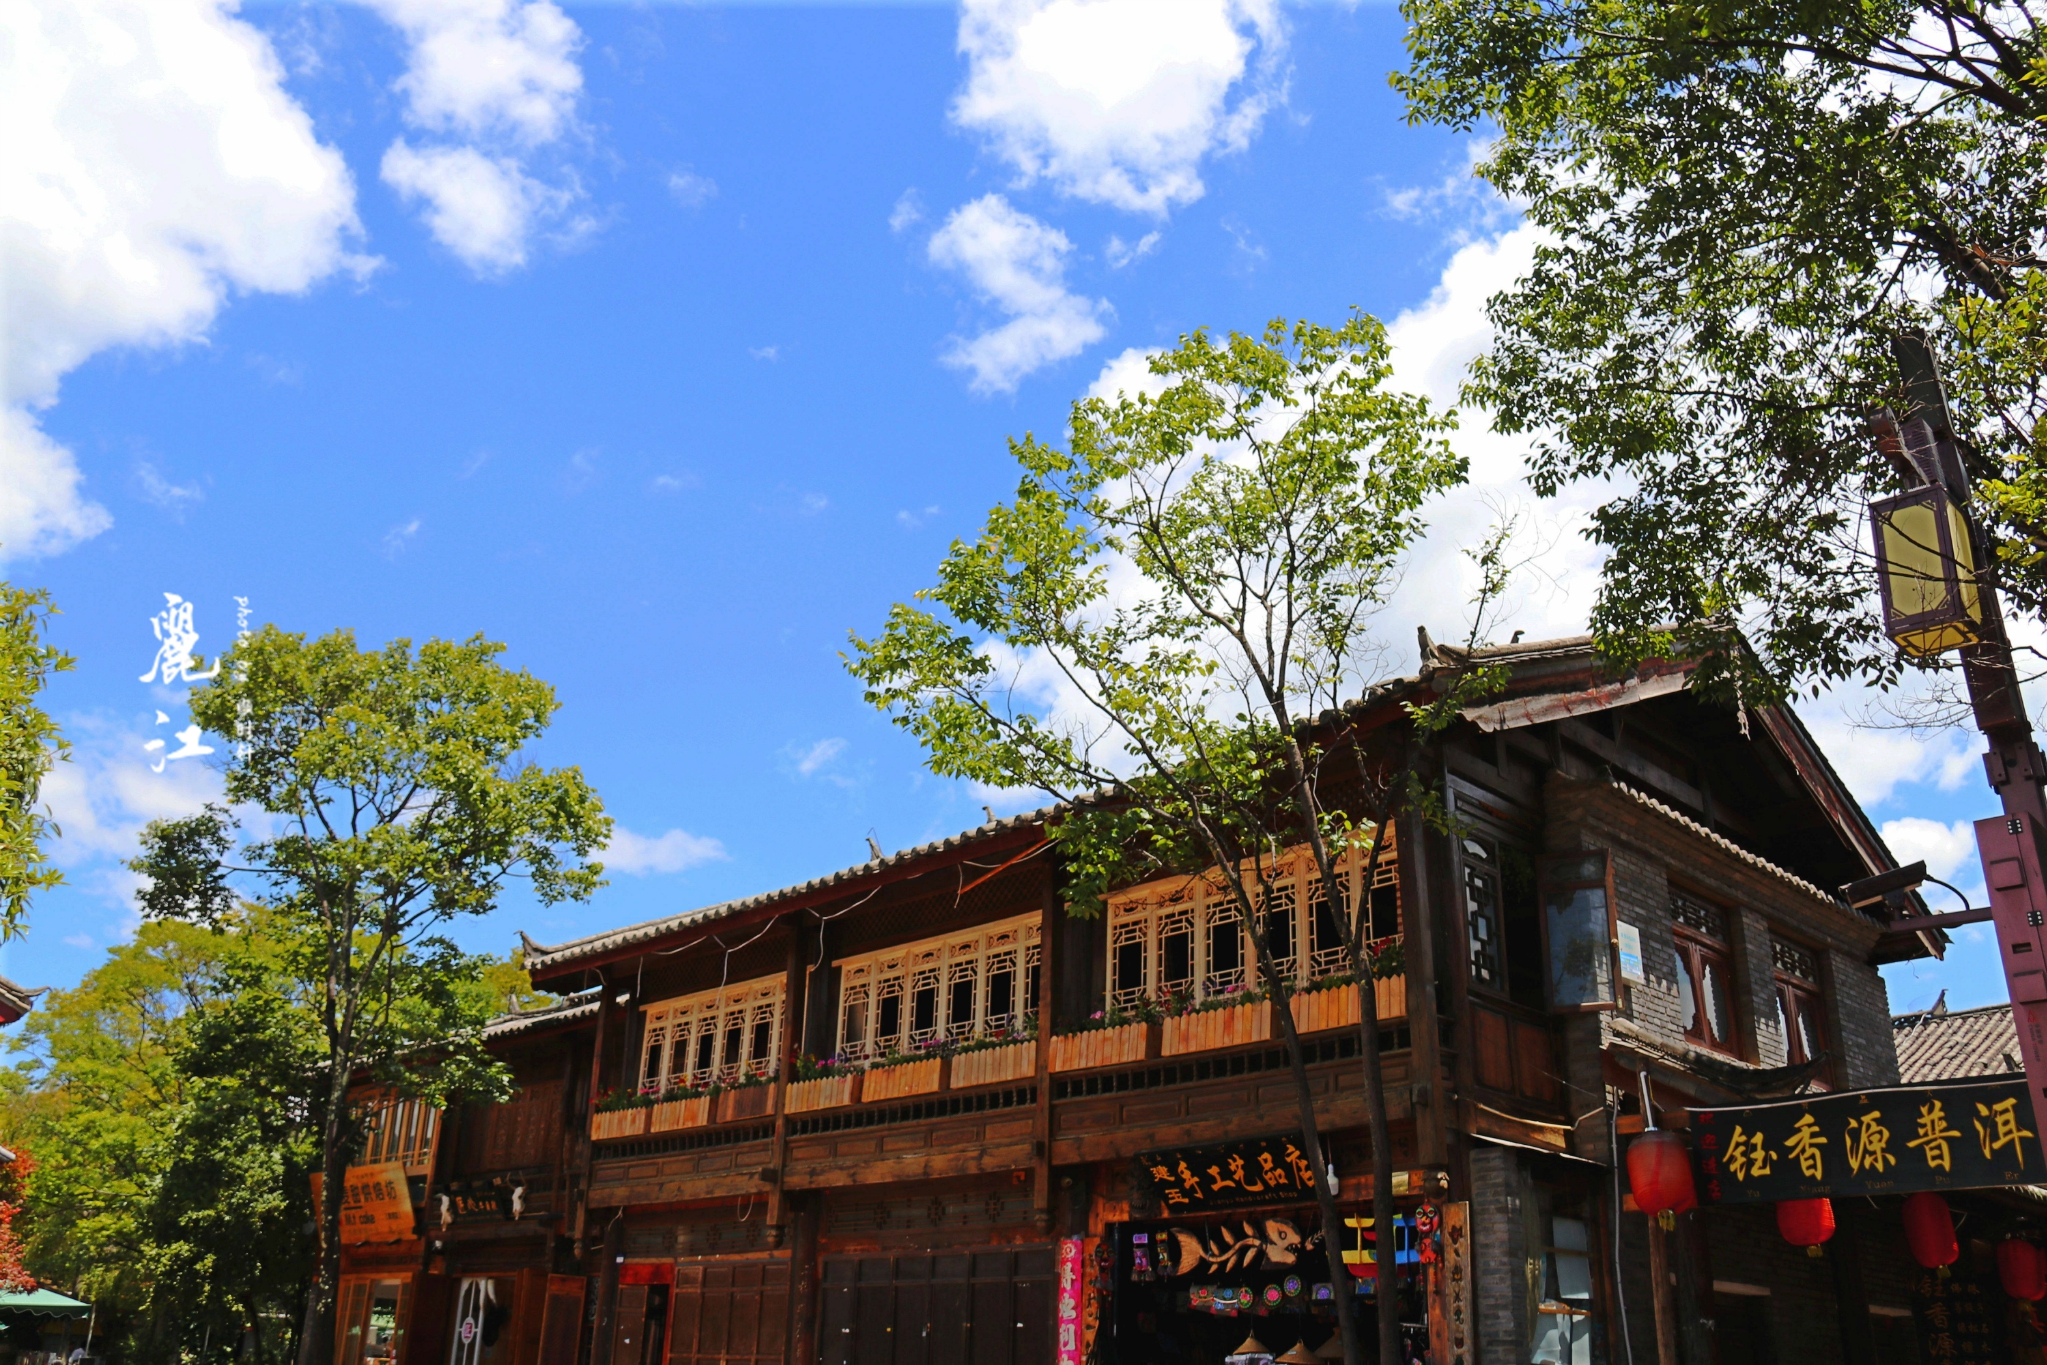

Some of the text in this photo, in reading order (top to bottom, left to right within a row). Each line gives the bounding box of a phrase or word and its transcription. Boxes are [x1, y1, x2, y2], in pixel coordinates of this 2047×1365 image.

[1723, 1097, 2035, 1183] 钰香源普洱
[1149, 1164, 1190, 1205] 建玉
[1177, 1143, 1316, 1200] 手工艺品店
[1279, 1189, 1299, 1199] Shop
[1864, 1178, 1895, 1189] Yuan
[1935, 1174, 1951, 1185] Pu
[2004, 1170, 2020, 1181] Er
[1918, 1275, 1958, 1365] 钰香源
